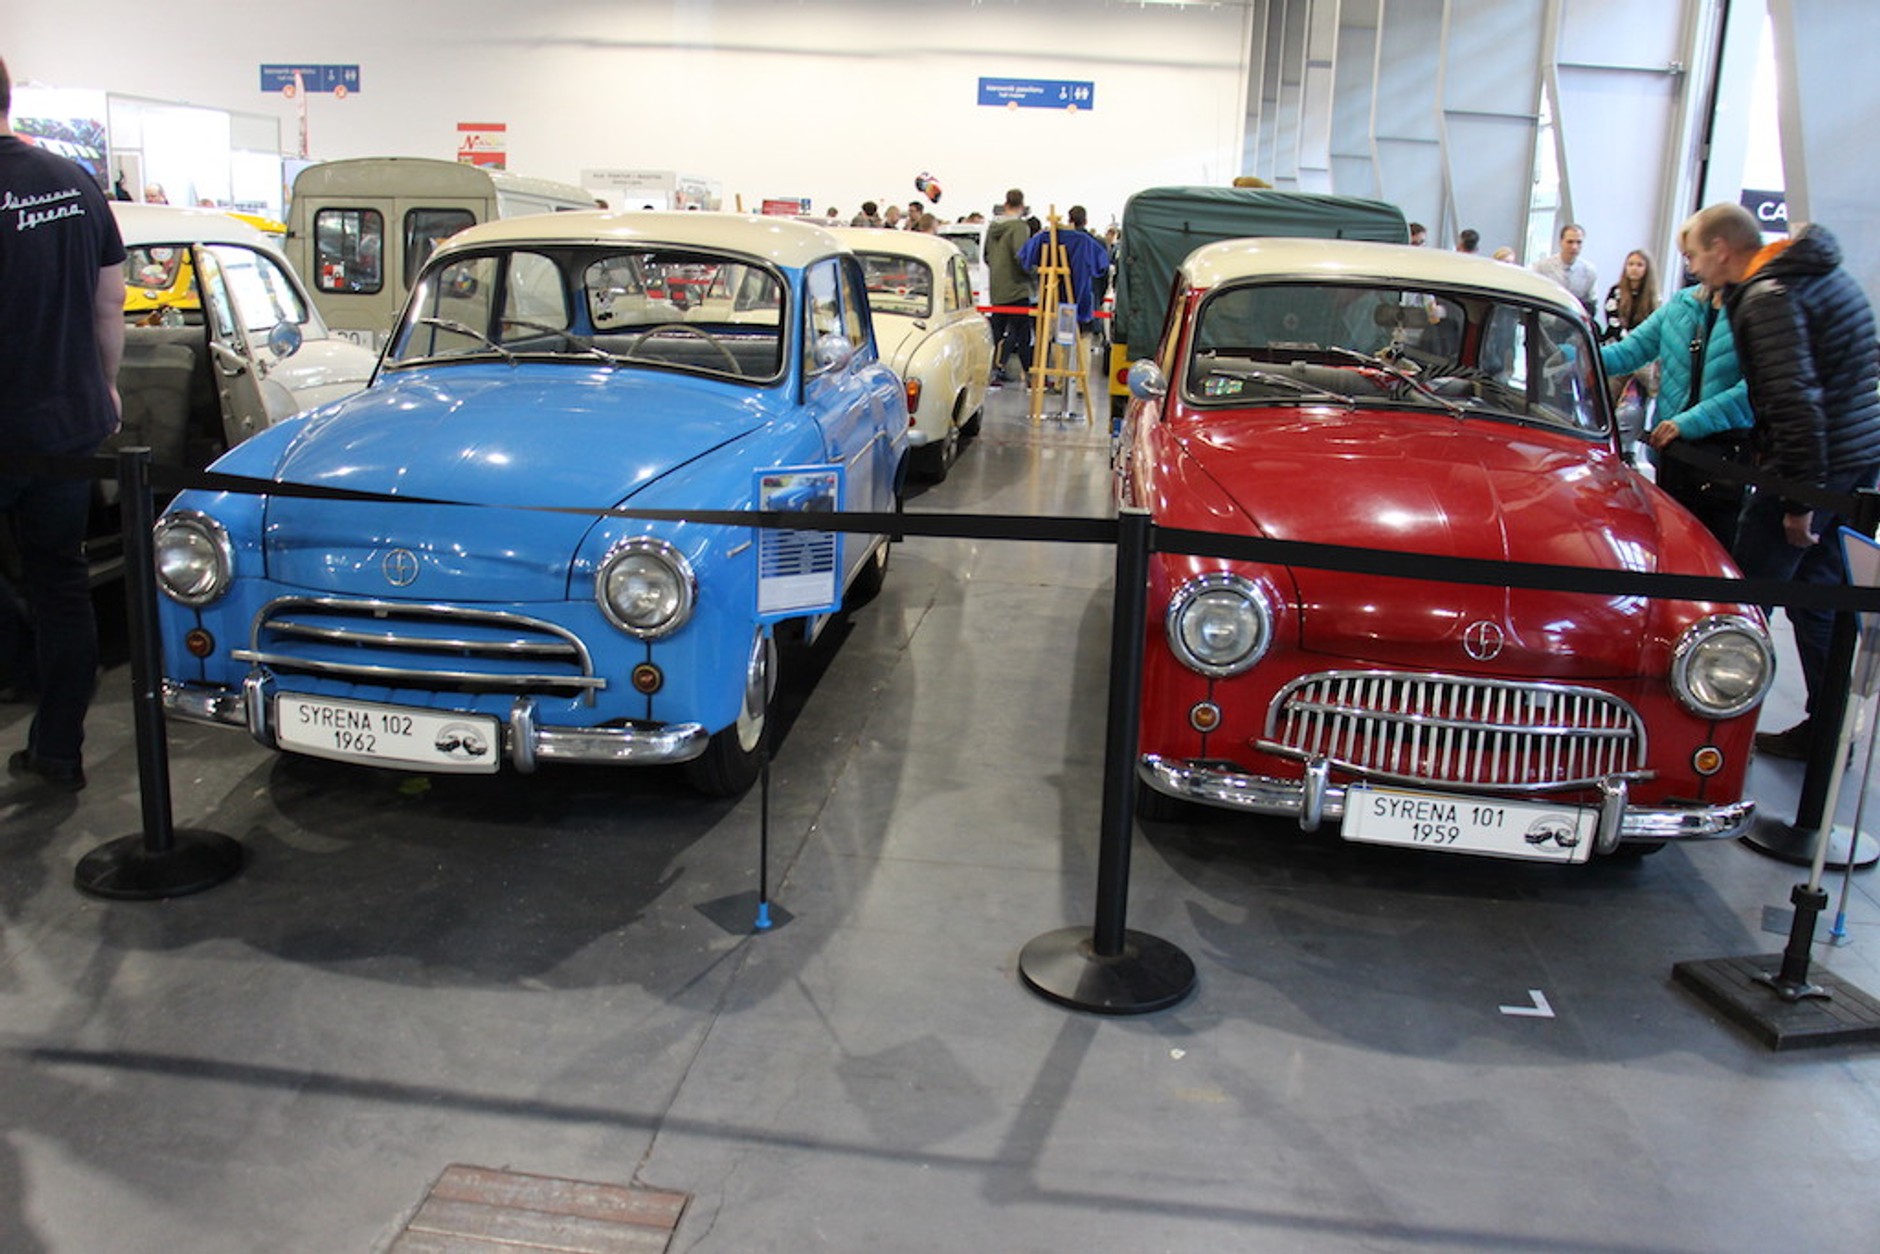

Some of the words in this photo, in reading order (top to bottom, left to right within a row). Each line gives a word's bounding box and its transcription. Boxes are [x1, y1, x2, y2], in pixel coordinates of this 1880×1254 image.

[299, 704, 371, 730] SYRENA
[382, 715, 412, 735] 102
[335, 731, 376, 752] 1962
[1374, 797, 1457, 822] SYRENA
[1472, 807, 1504, 827] 101
[1412, 823, 1459, 844] 1959
